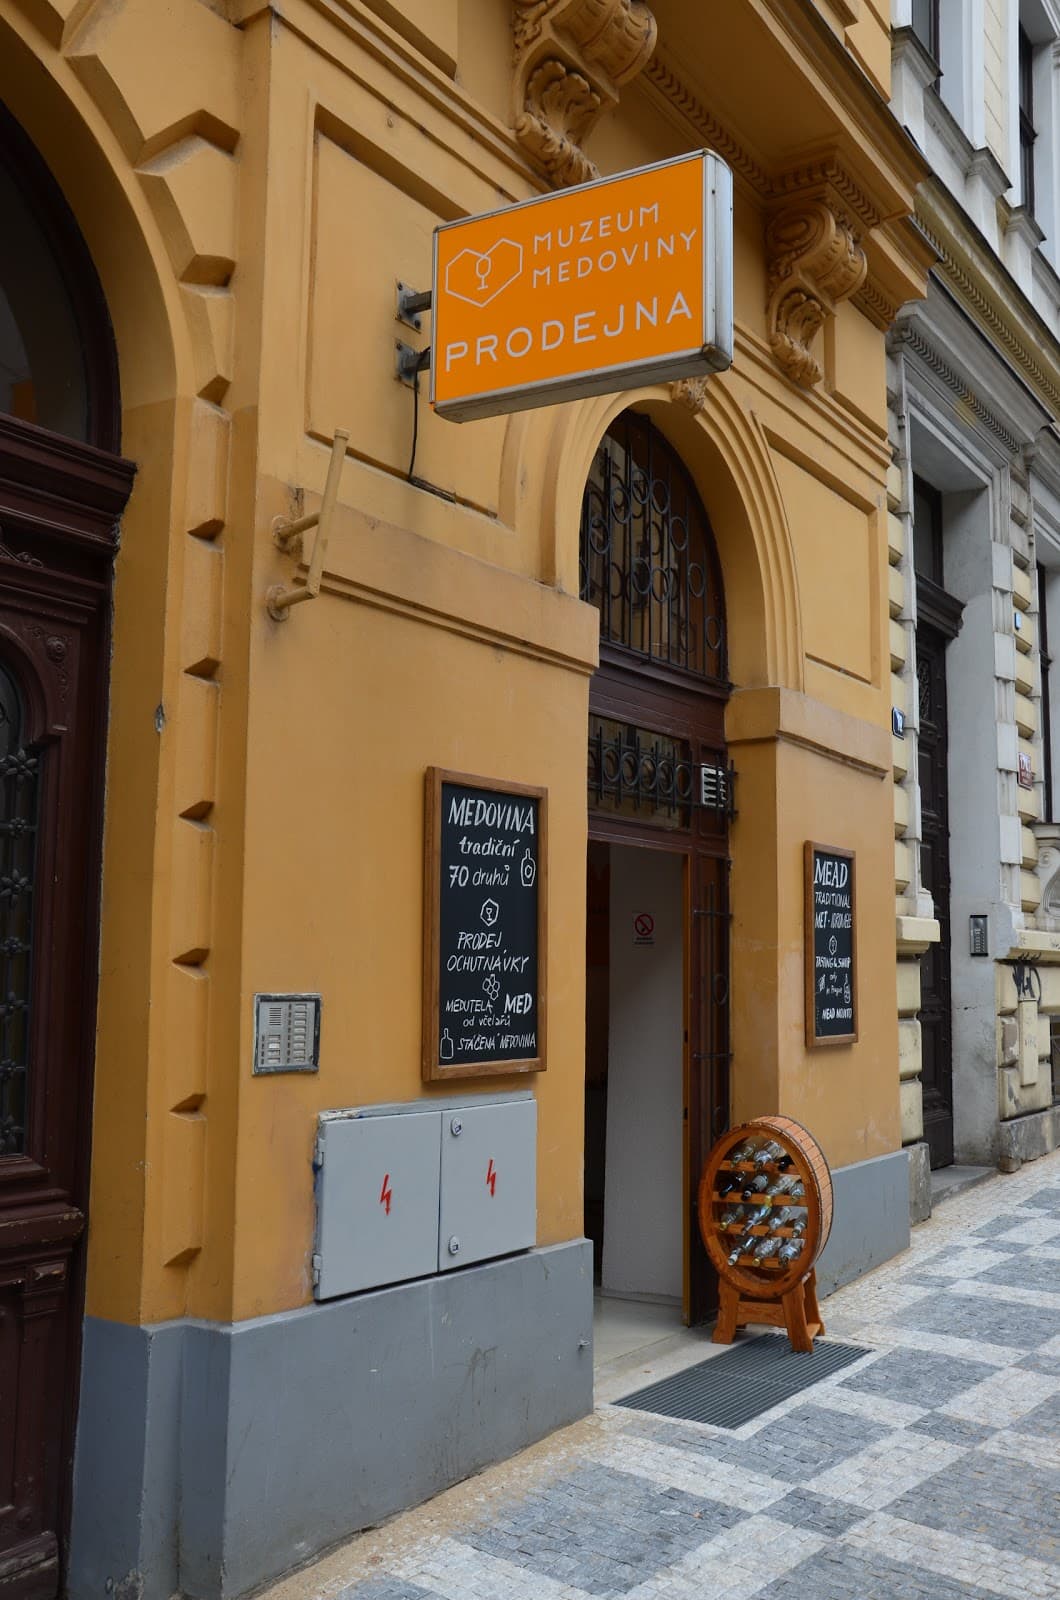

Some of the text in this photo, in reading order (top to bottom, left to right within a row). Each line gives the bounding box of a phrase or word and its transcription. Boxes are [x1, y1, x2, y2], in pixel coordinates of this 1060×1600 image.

[533, 202, 660, 255] MUZEUM
[532, 228, 697, 289] MEDOVINY
[445, 291, 693, 373] PRODEJNA
[448, 797, 535, 835] MEDOVINA
[459, 836, 520, 857] tradiční
[449, 864, 510, 888] 70 druhů
[813, 858, 848, 888] MEAD
[815, 891, 851, 909] TRADITIONAL
[457, 931, 502, 950] PRODEJ
[447, 949, 530, 973] OCHUTNÁVKY
[504, 993, 533, 1014] MED
[463, 1015, 475, 1027] od
